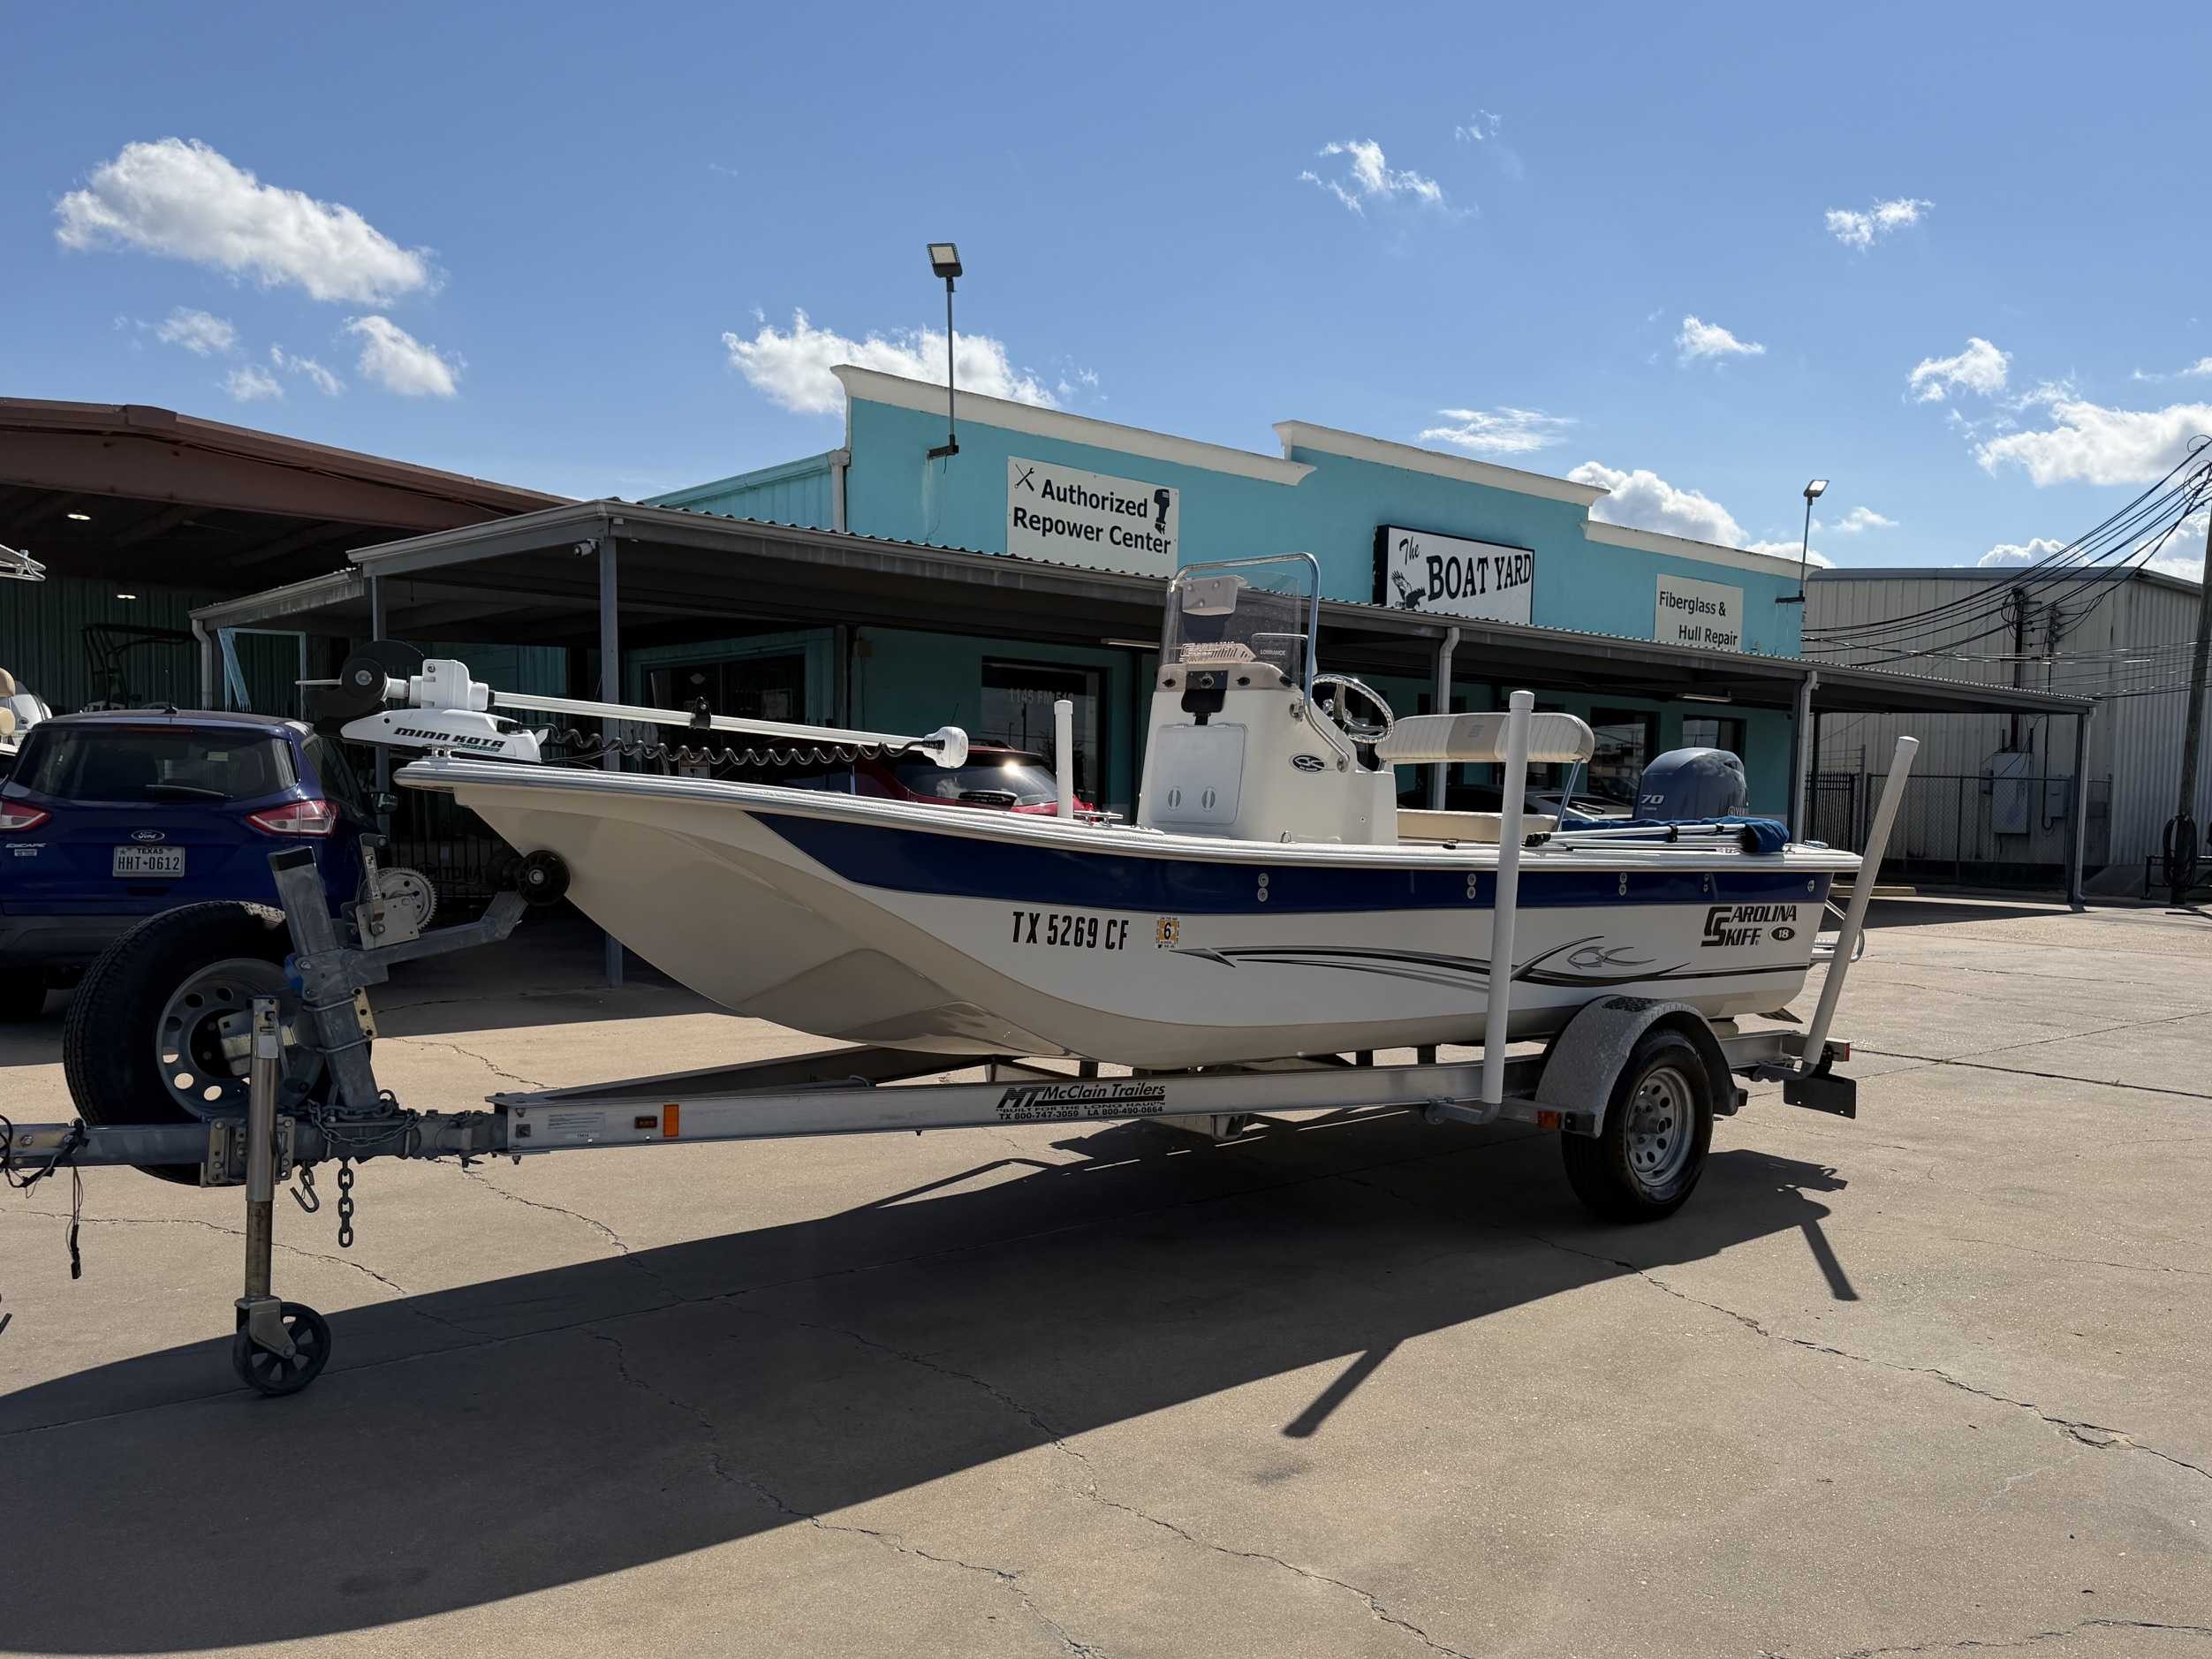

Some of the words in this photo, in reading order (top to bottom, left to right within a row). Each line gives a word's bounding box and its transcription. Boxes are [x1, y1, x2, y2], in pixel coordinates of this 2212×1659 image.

[1041, 479, 1148, 519] Authorized
[1012, 505, 1104, 543] Repower
[1109, 524, 1172, 555] Center
[1398, 535, 1420, 565] The
[1426, 554, 1489, 602] BOAT
[1494, 553, 1533, 591] YARD
[1659, 591, 1716, 615] Fiberglass
[1718, 601, 1726, 617] &
[1678, 624, 1701, 641] Hull
[1704, 627, 1739, 648] Repair
[1640, 794, 1665, 805] 70
[1012, 912, 1041, 943] TX
[1046, 914, 1099, 949] 5269
[1104, 919, 1130, 951] CF
[1163, 921, 1172, 941] 6
[1701, 916, 1763, 947] SKIFF
[1703, 905, 1798, 936] CAROLINA
[996, 1087, 1046, 1109] MT
[1042, 1085, 1108, 1101] McClain
[1110, 1082, 1166, 1096] Trailers
[1015, 1110, 1079, 1119] 800-747-3059
